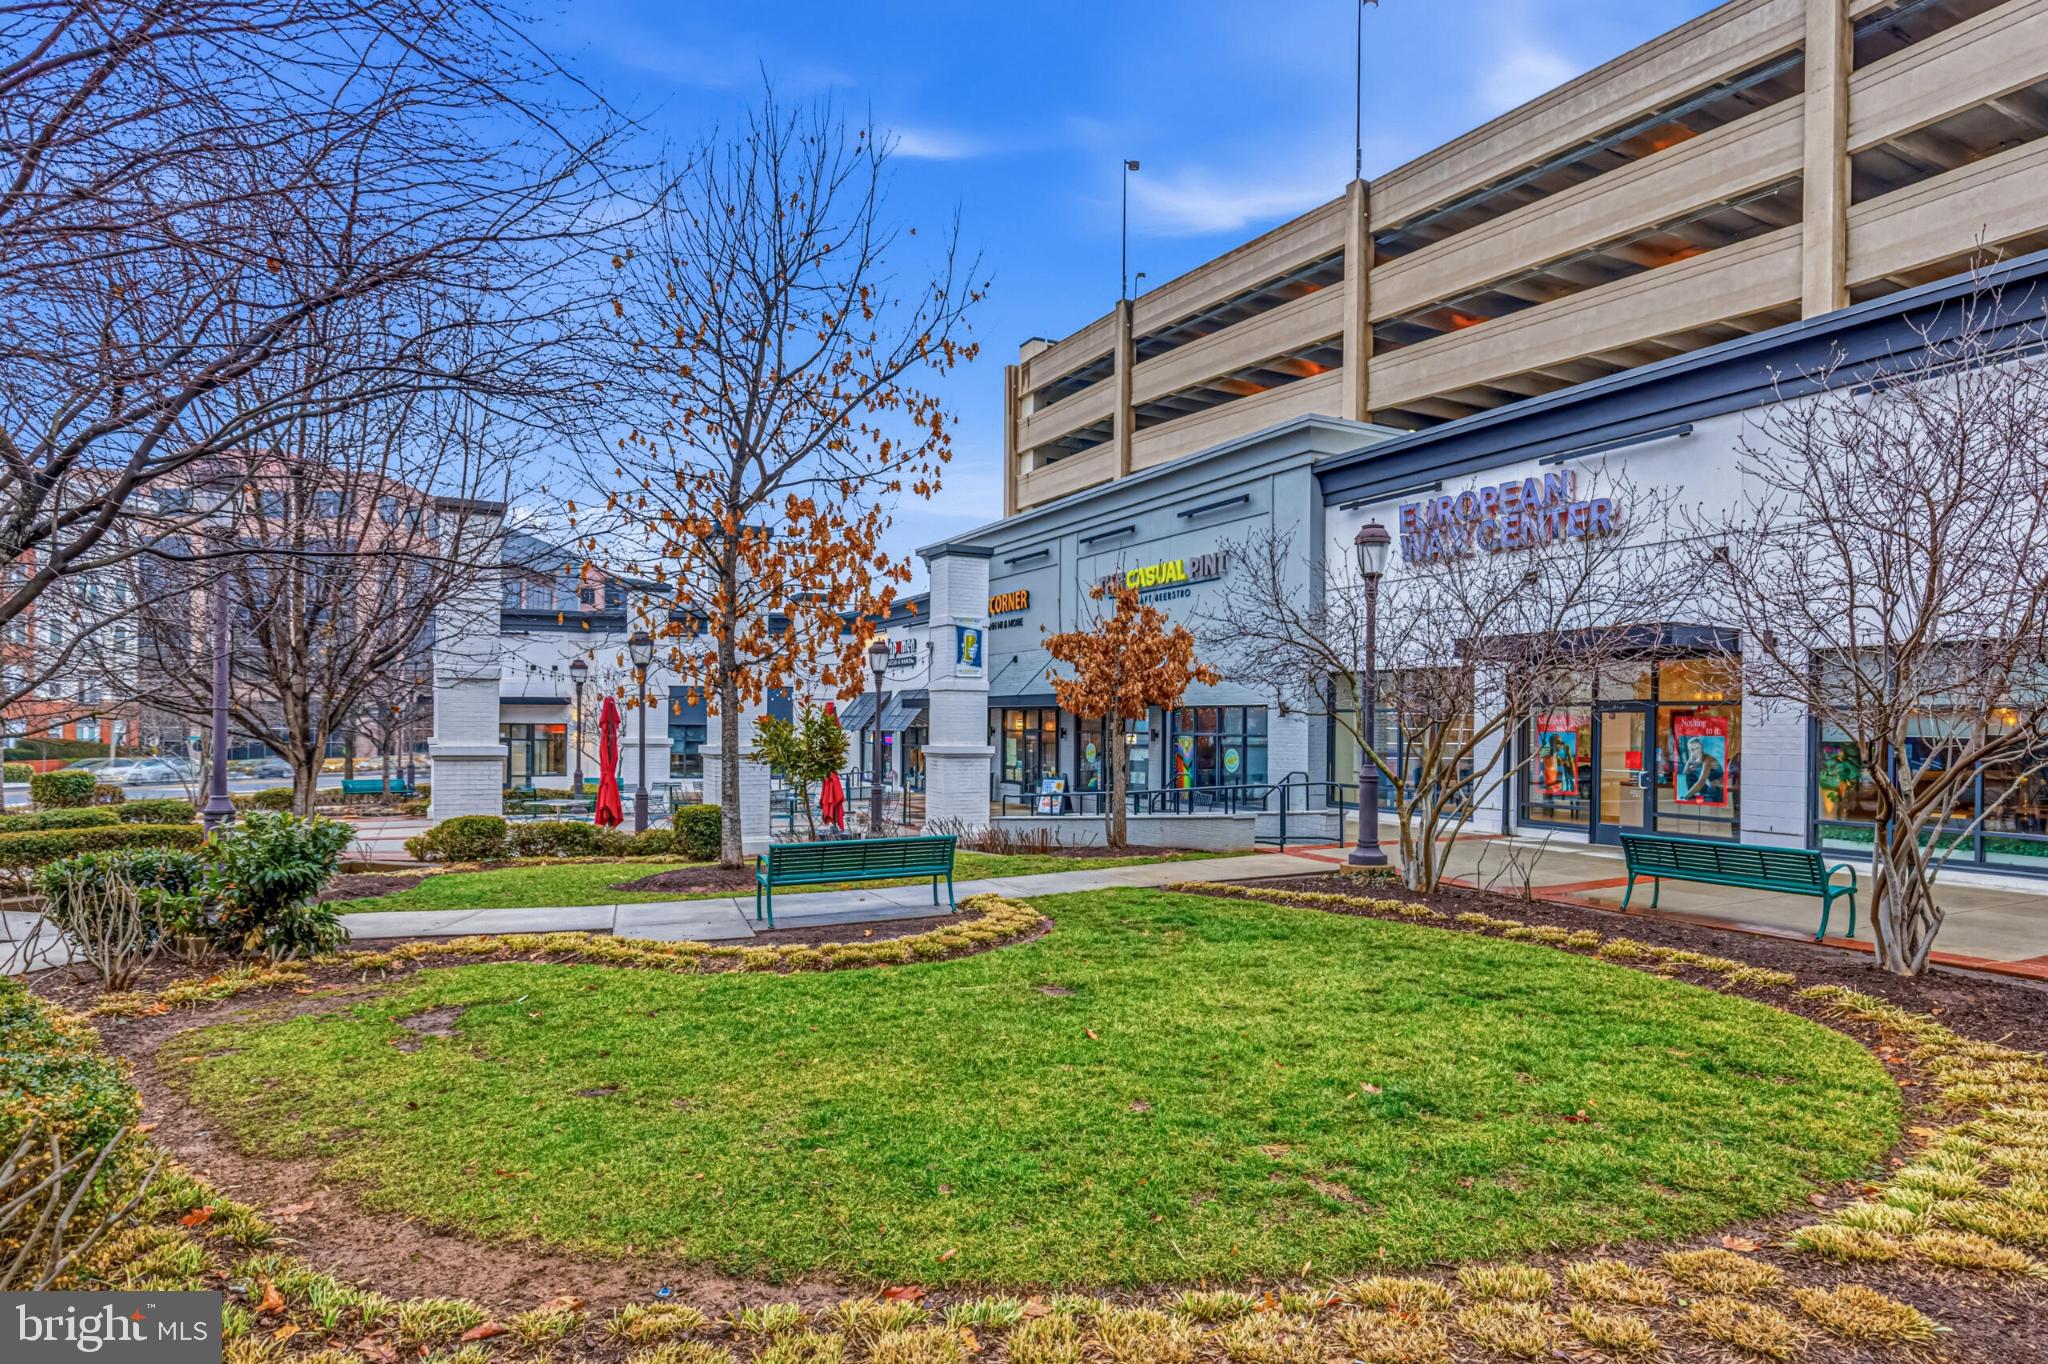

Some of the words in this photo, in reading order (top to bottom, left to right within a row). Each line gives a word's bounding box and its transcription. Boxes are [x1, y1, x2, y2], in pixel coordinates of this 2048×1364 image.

[1399, 468, 1572, 534] EUROPEAN
[1401, 524, 1472, 562] WAX
[1477, 498, 1614, 551] CENTER
[1126, 559, 1188, 589] CASUAL
[1190, 551, 1229, 579] PINT
[989, 590, 1029, 616] CORNER
[1681, 718, 1707, 729] Nothing
